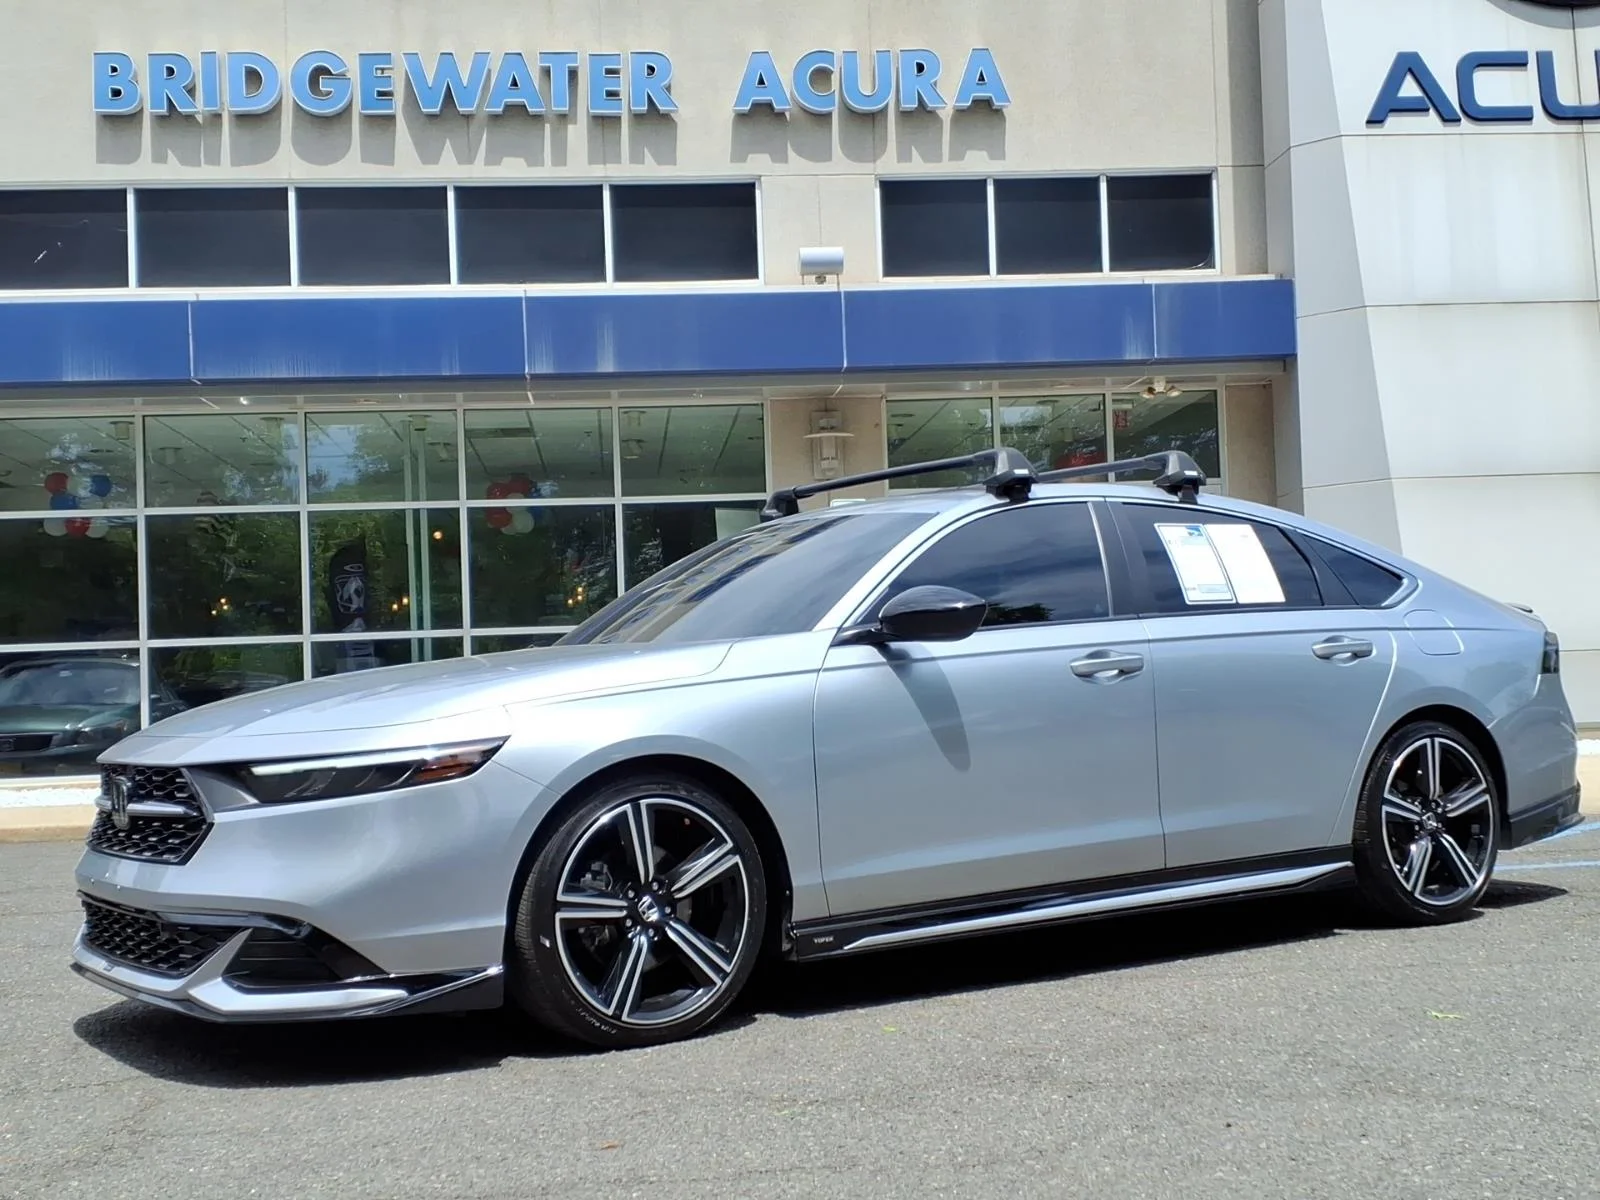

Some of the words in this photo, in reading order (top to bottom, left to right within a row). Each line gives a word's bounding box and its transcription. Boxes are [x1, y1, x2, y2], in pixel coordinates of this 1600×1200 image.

[92, 50, 679, 117] BRIDGEWATER
[733, 46, 1011, 115] ACURA
[1366, 50, 1600, 124] ACU
